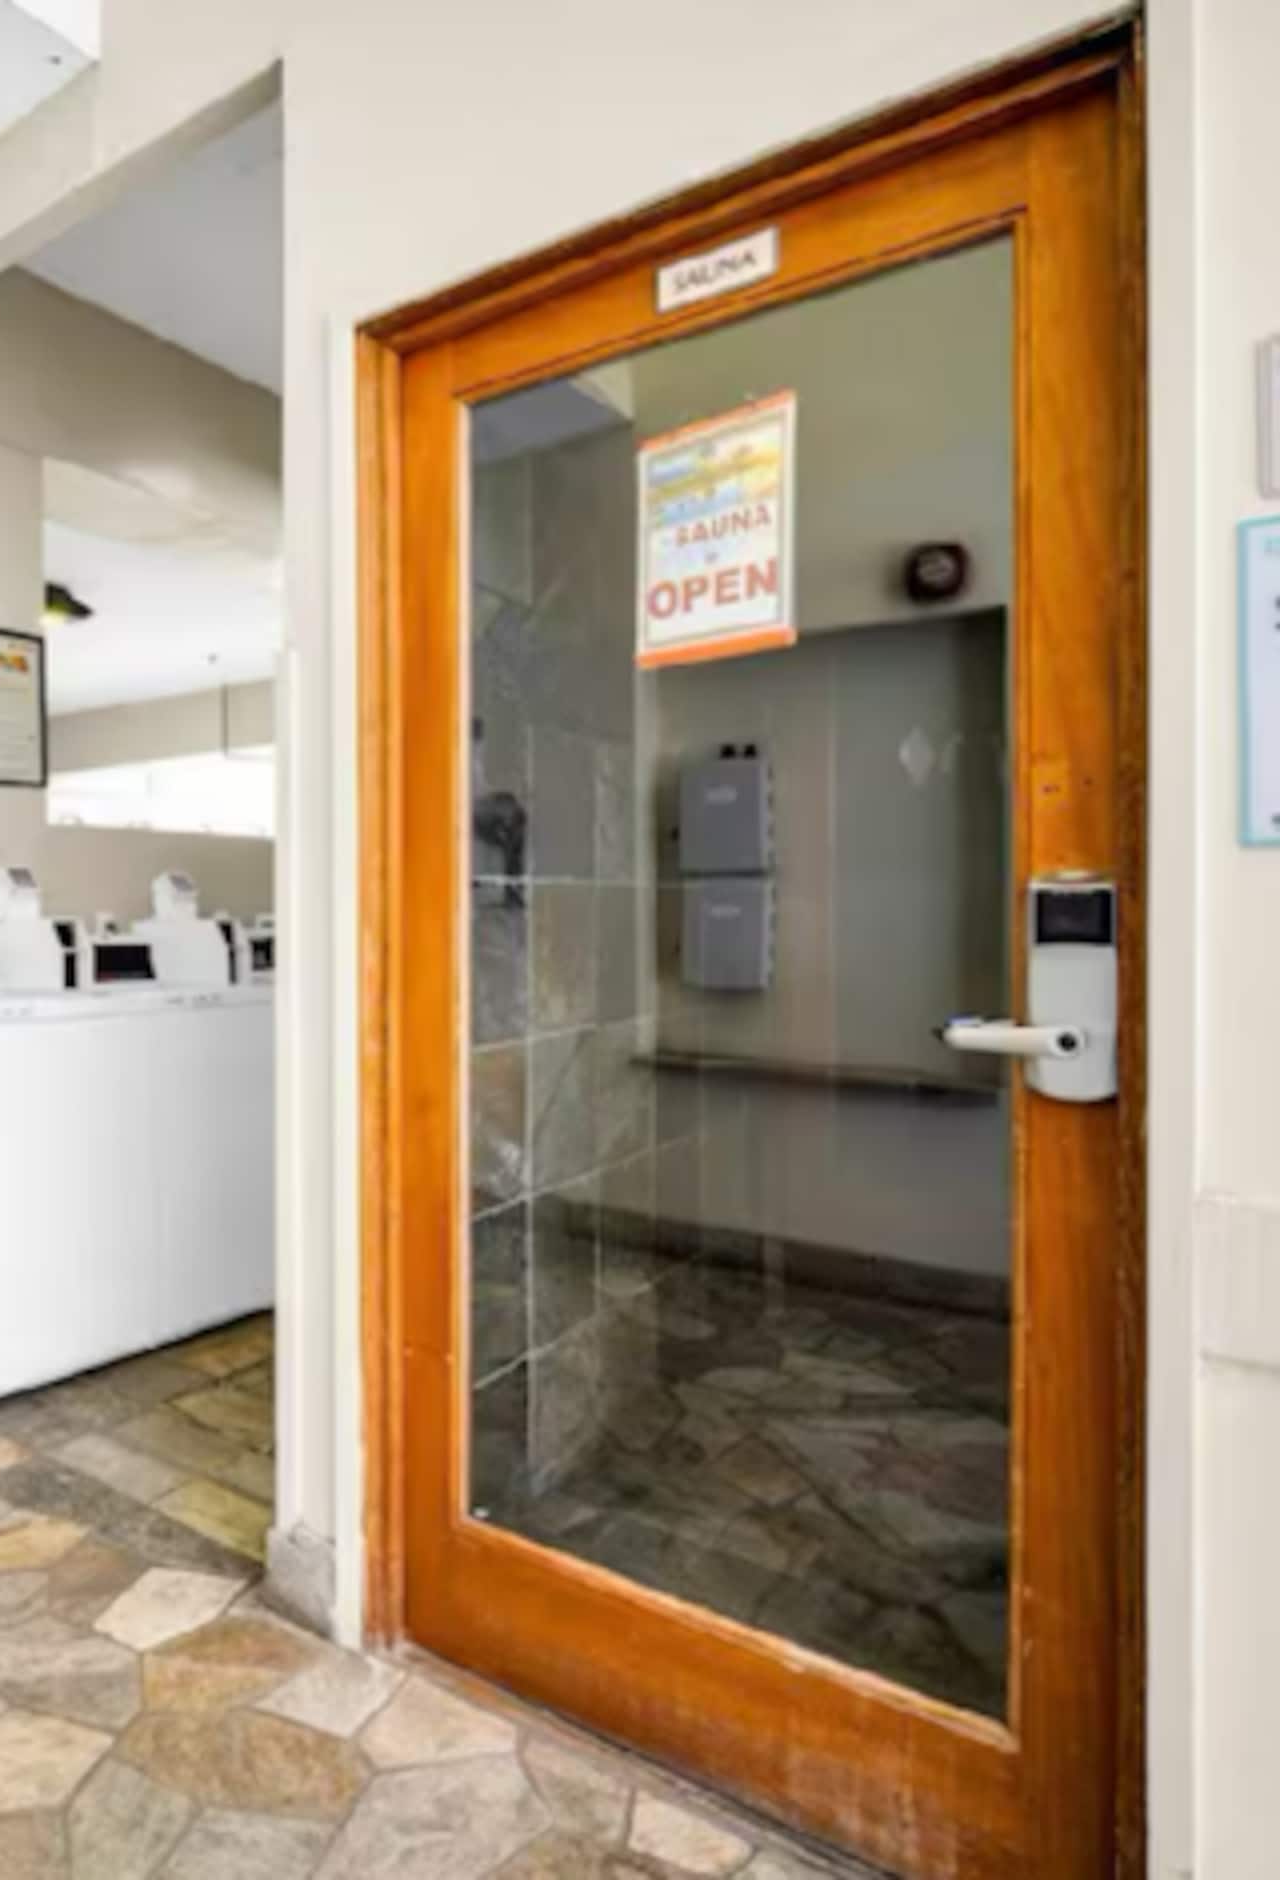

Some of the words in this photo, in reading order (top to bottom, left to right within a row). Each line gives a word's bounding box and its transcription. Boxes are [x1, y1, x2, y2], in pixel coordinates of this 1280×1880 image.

[674, 251, 757, 291] SAUNA
[676, 504, 771, 546] SAUNA
[647, 557, 779, 620] OPEN
